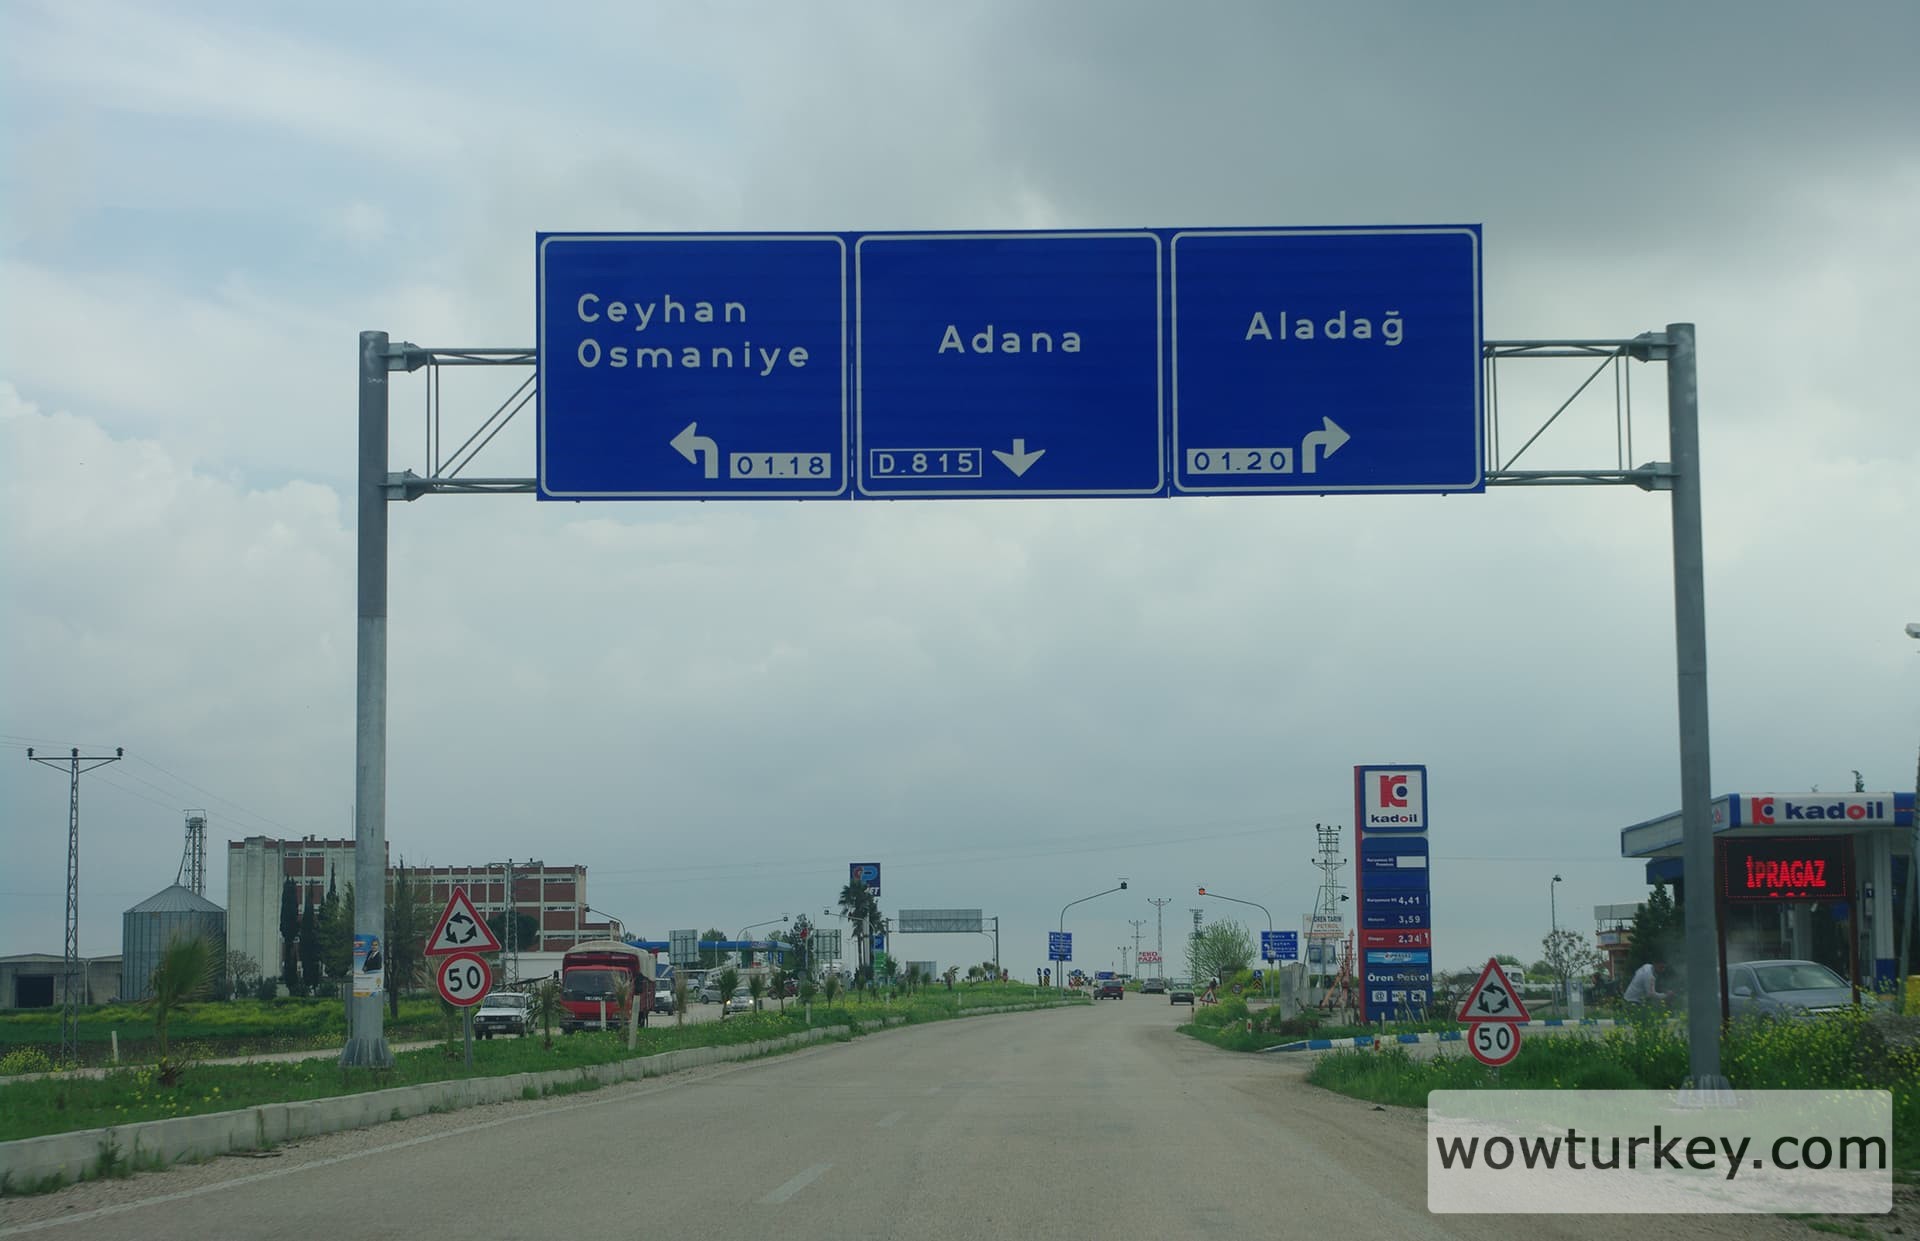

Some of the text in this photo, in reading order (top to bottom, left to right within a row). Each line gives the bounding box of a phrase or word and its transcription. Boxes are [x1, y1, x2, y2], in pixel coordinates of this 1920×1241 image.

[577, 293, 747, 331] Ceyhan
[937, 324, 1082, 354] Adana
[1245, 310, 1404, 347] Aladağ
[577, 338, 809, 376] Osmaniye
[737, 456, 825, 475] 01.18
[879, 453, 974, 473] D.815
[1194, 451, 1287, 472] 01.20
[1371, 813, 1418, 824] kadoil
[1785, 801, 1884, 821] kadoil
[1745, 855, 1827, 888] İPRAGAZ
[1398, 895, 1420, 906] 4,41
[1398, 914, 1421, 925] 3,59
[448, 966, 481, 993] 50
[1368, 972, 1394, 982] Ören
[1479, 1027, 1510, 1051] 50
